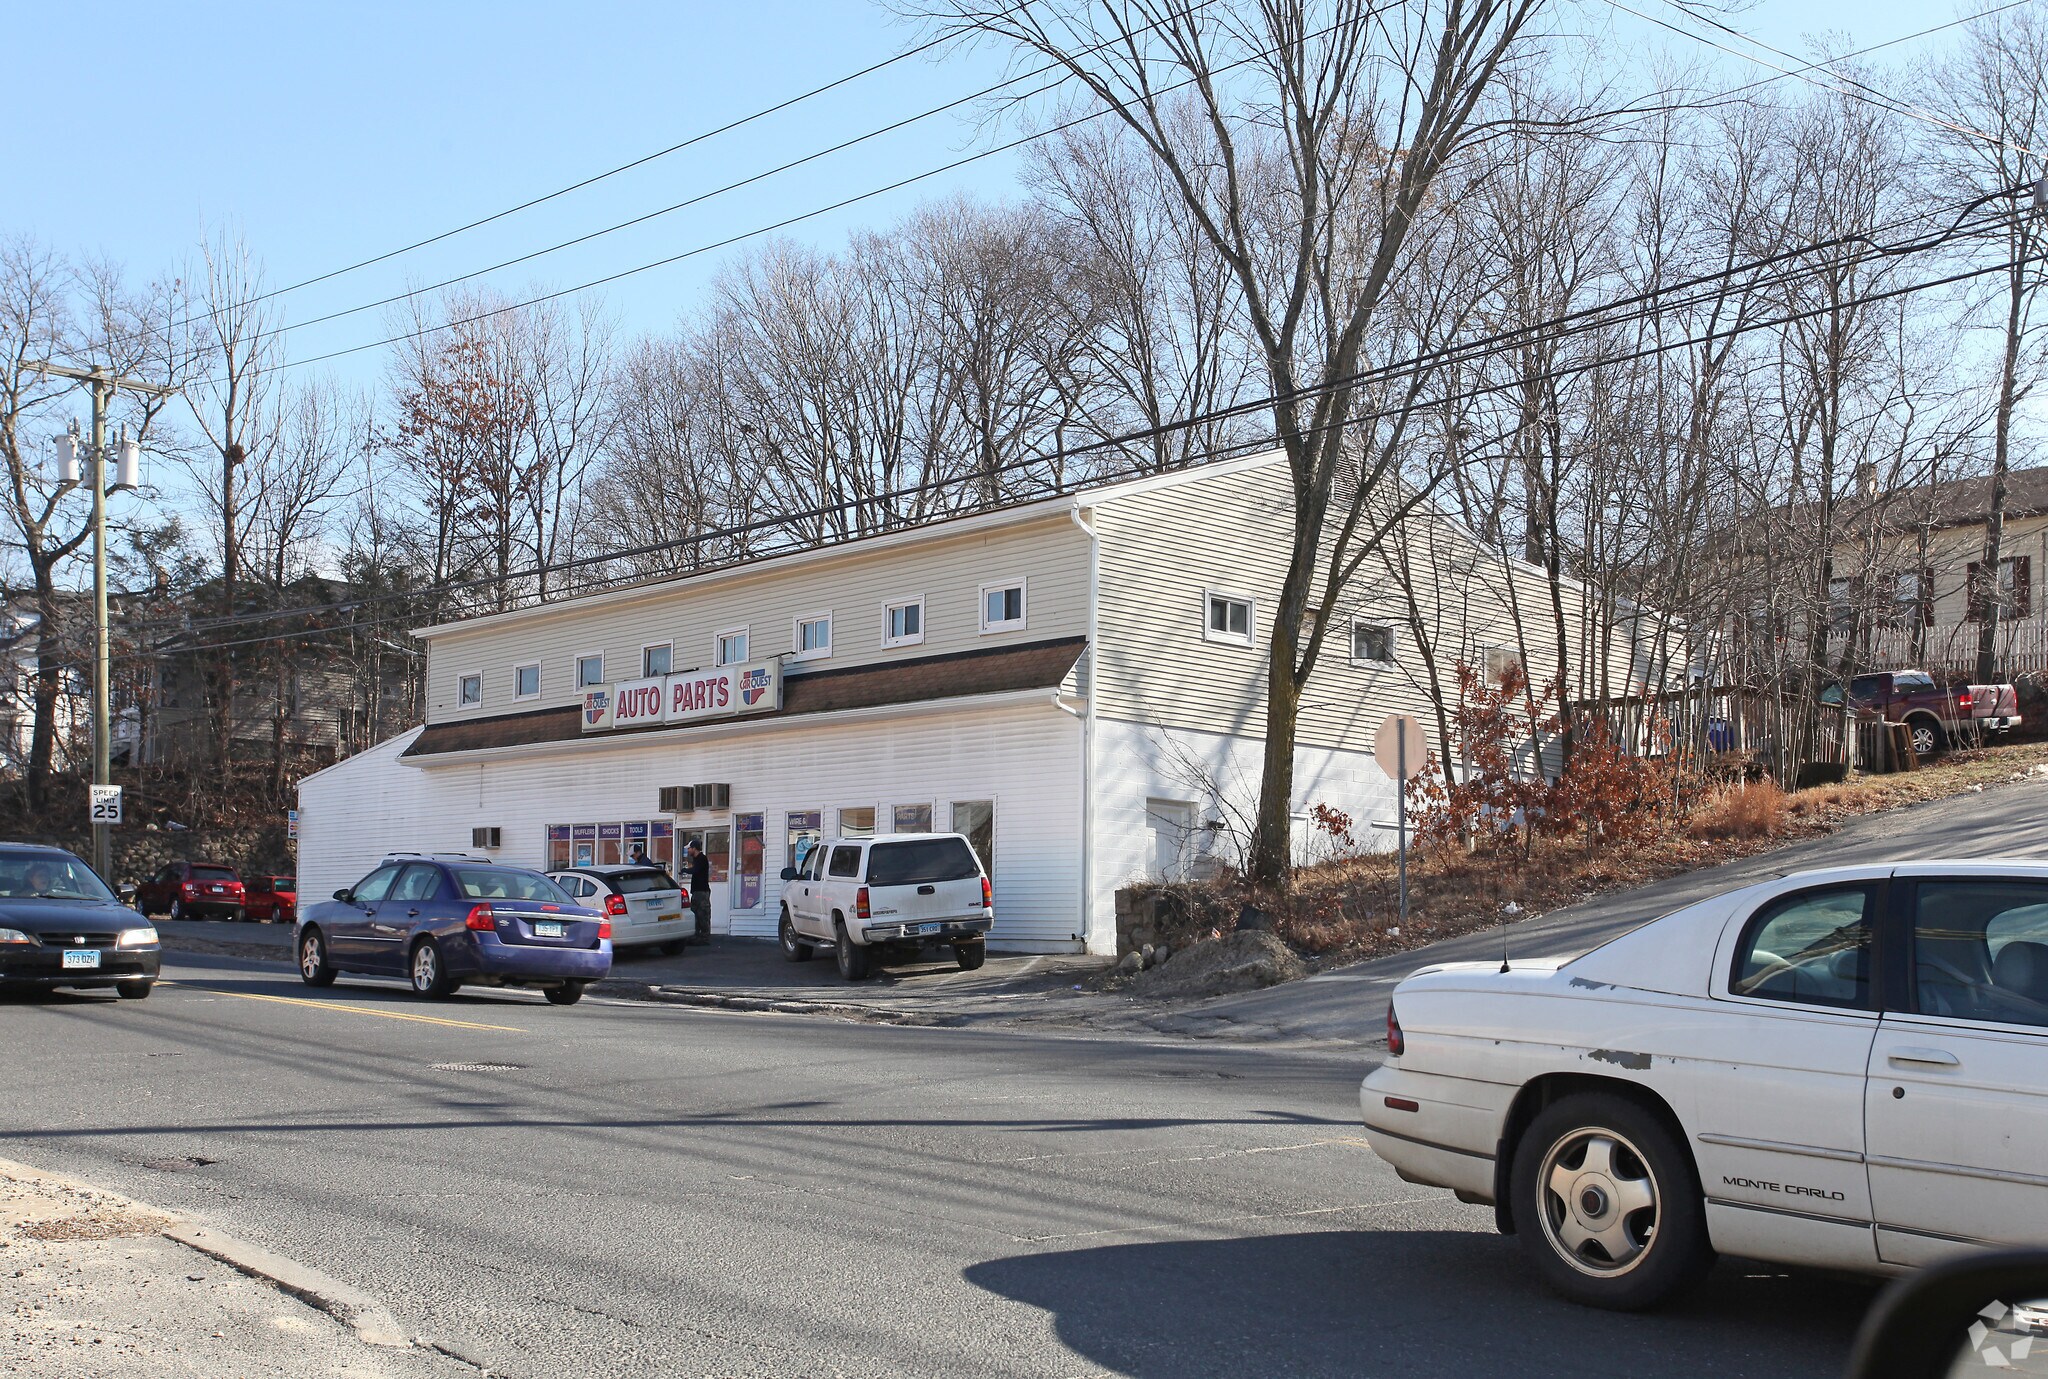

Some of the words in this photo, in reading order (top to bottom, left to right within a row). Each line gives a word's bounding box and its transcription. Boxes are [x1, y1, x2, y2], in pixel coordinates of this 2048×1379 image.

[739, 674, 772, 691] CARQUEST
[583, 697, 611, 709] CARQUEST
[616, 686, 661, 719] AUTO
[672, 676, 729, 713] PARTS
[93, 804, 118, 819] 25
[789, 817, 802, 826] WIRE
[67, 955, 80, 964] 373
[1722, 1176, 1780, 1192] MONTE
[1785, 1184, 1845, 1201] CARLO
